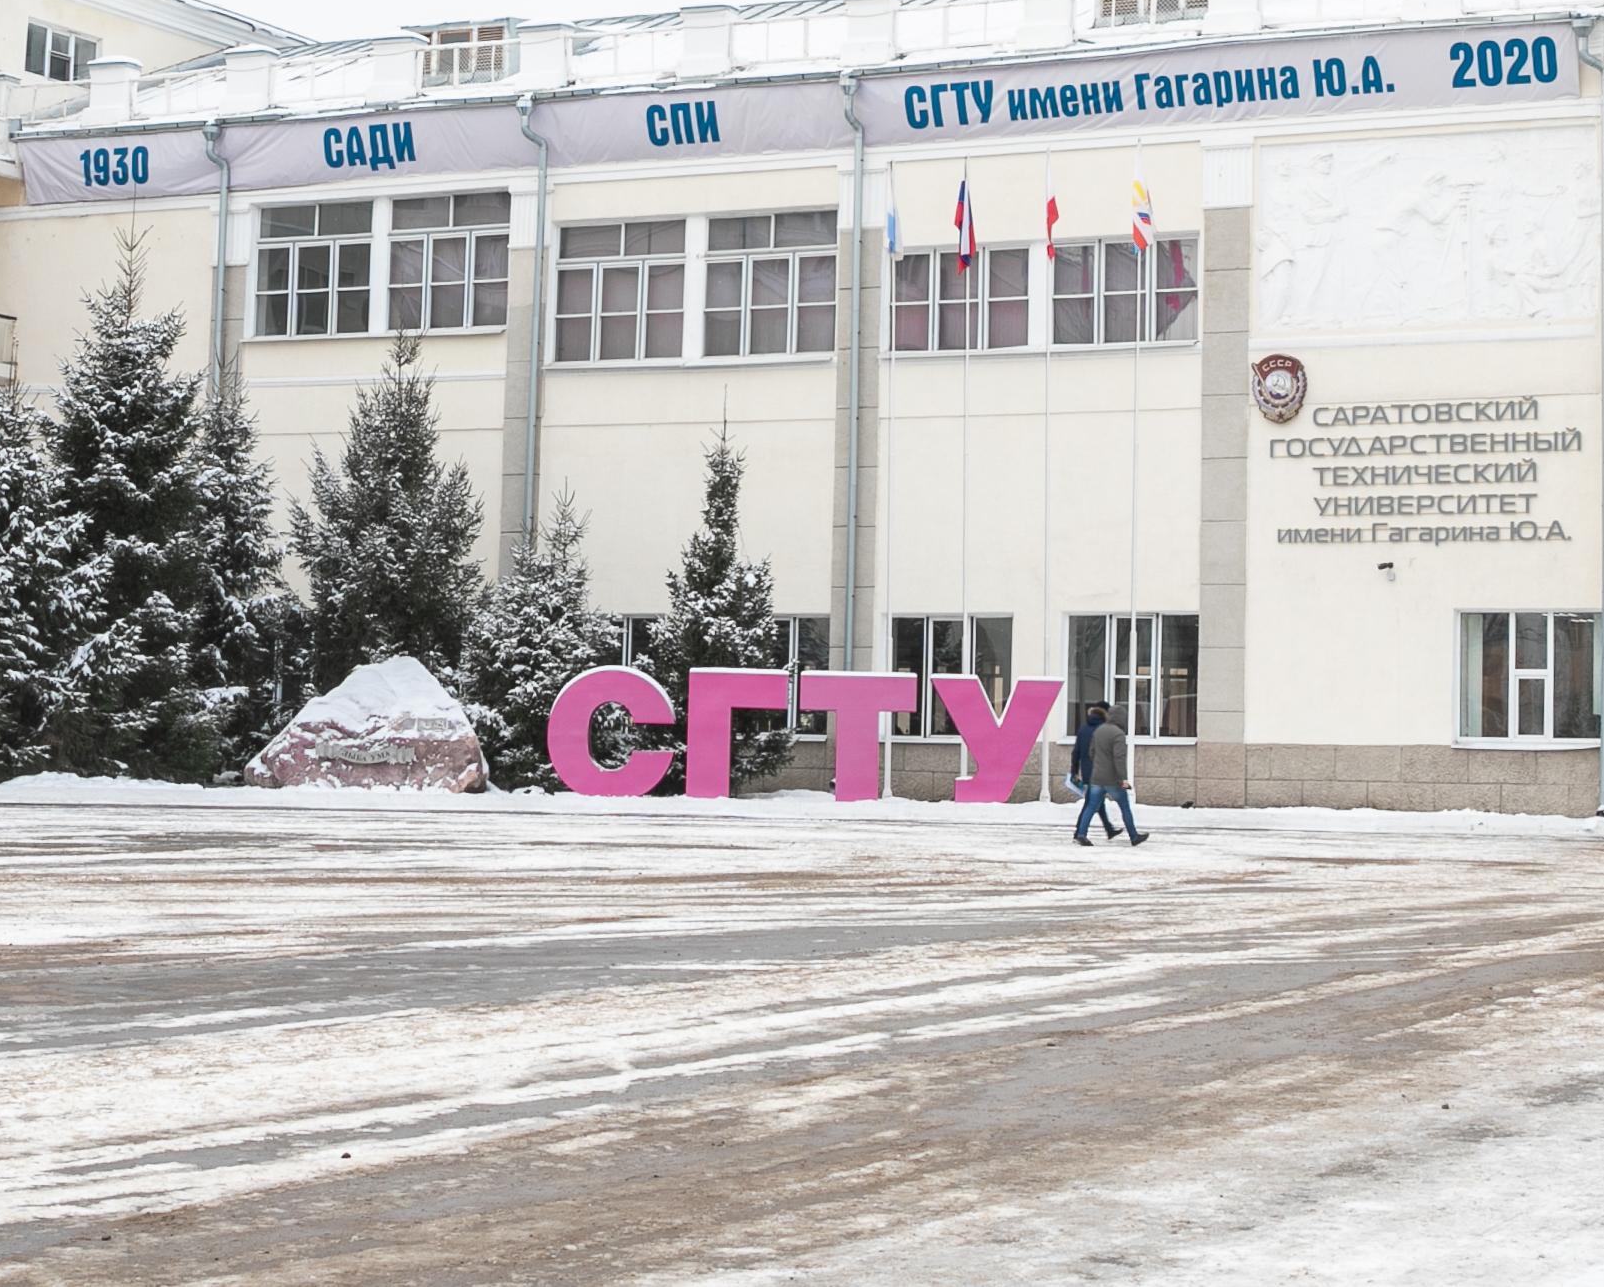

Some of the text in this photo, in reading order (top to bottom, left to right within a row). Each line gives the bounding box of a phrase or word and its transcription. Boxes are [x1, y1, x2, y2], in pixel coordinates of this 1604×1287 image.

[1449, 36, 1558, 89] 2020
[903, 56, 1396, 130] СГТУ имени Гагарина Ю.А.
[645, 100, 720, 147] СПИ
[322, 120, 416, 170] САДИ
[79, 145, 149, 187] 1930
[1261, 359, 1293, 372] СССР
[1312, 395, 1540, 427] САРАТОВСКИЙ
[1269, 427, 1583, 459] ГОСУДАРСТВЕННЫЙ
[1312, 458, 1538, 487] ТЕХНИЧЕСКИЙ
[1313, 493, 1539, 517] УНИВЕРСИТЕТ
[1277, 519, 1572, 546] имени Гагарина Ю.А.
[547, 666, 1064, 804] СГТУ
